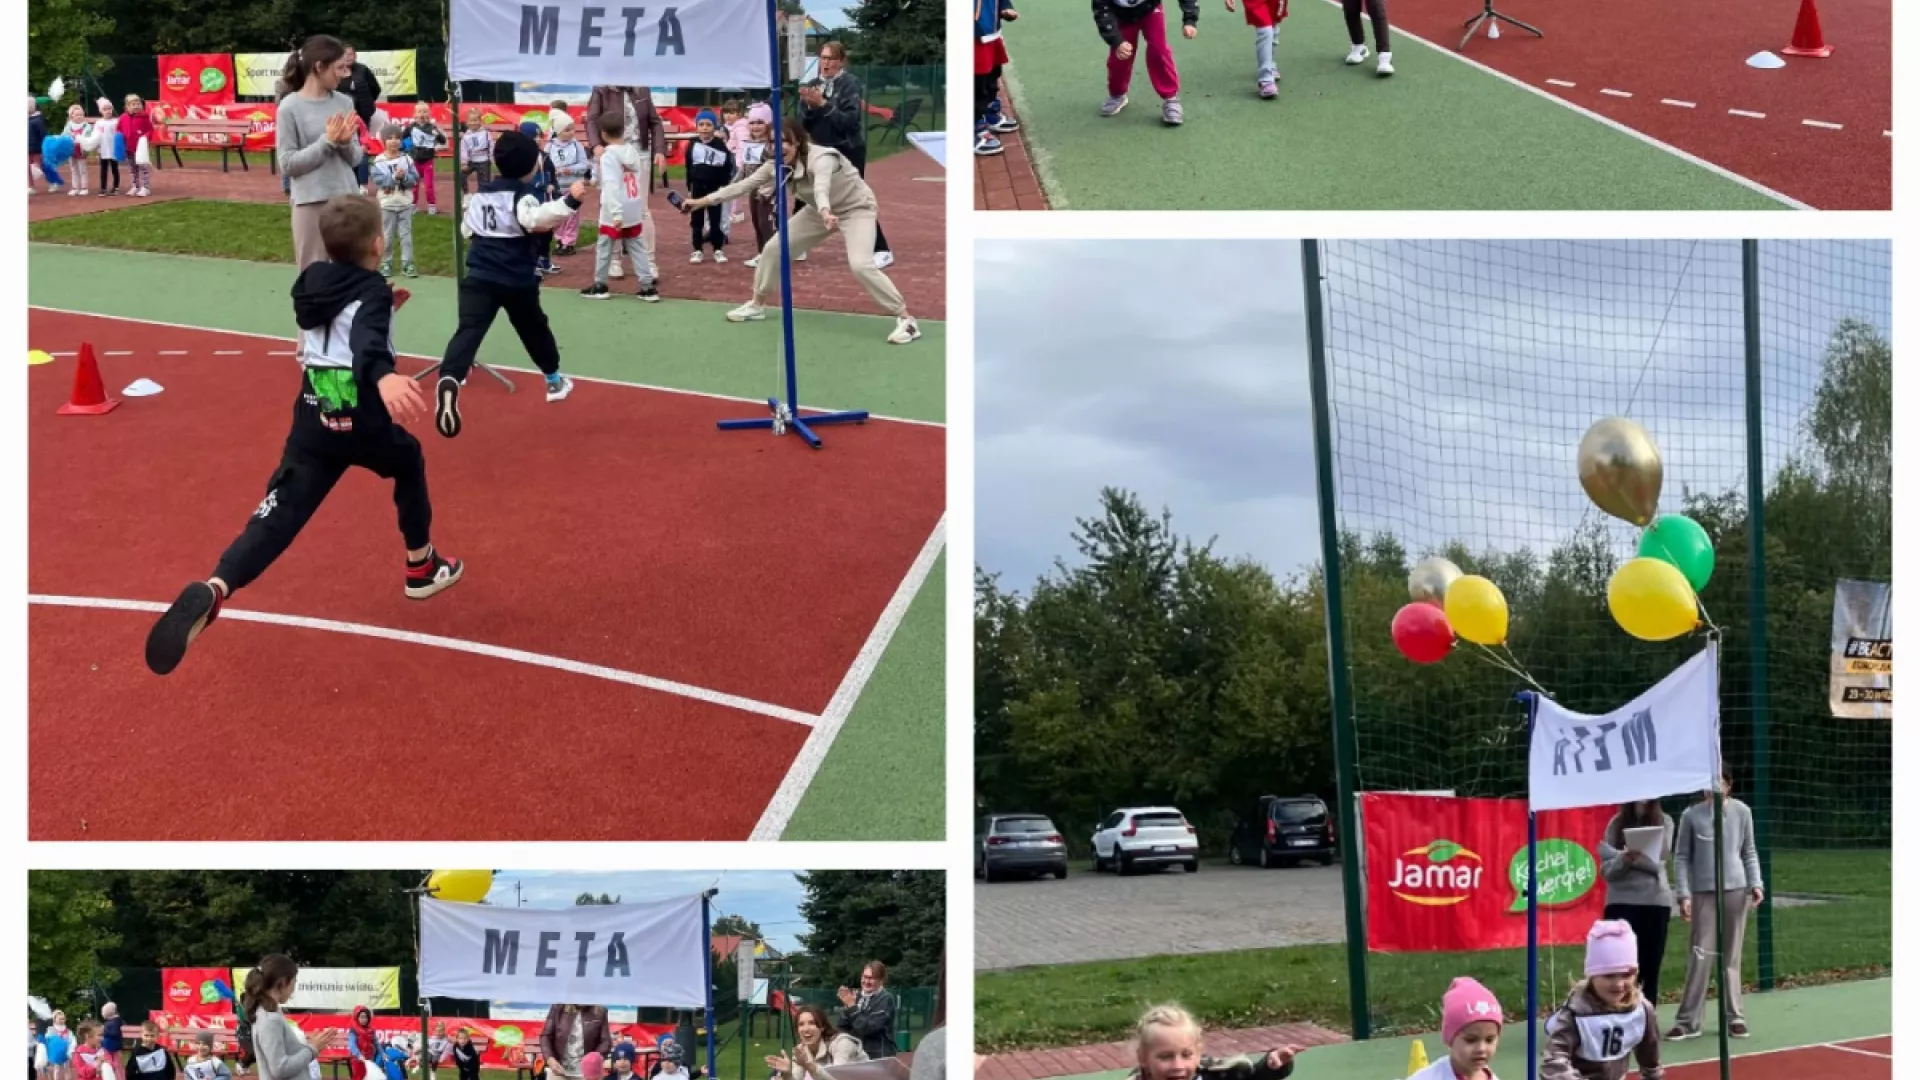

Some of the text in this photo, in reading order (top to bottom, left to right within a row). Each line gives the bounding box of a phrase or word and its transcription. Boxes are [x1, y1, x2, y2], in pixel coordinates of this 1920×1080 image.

[518, 4, 686, 57] META
[624, 171, 639, 198] 13
[482, 204, 498, 231] 13
[1388, 858, 1484, 890] Jamar
[482, 928, 631, 977] META
[1602, 1026, 1624, 1057] 16
